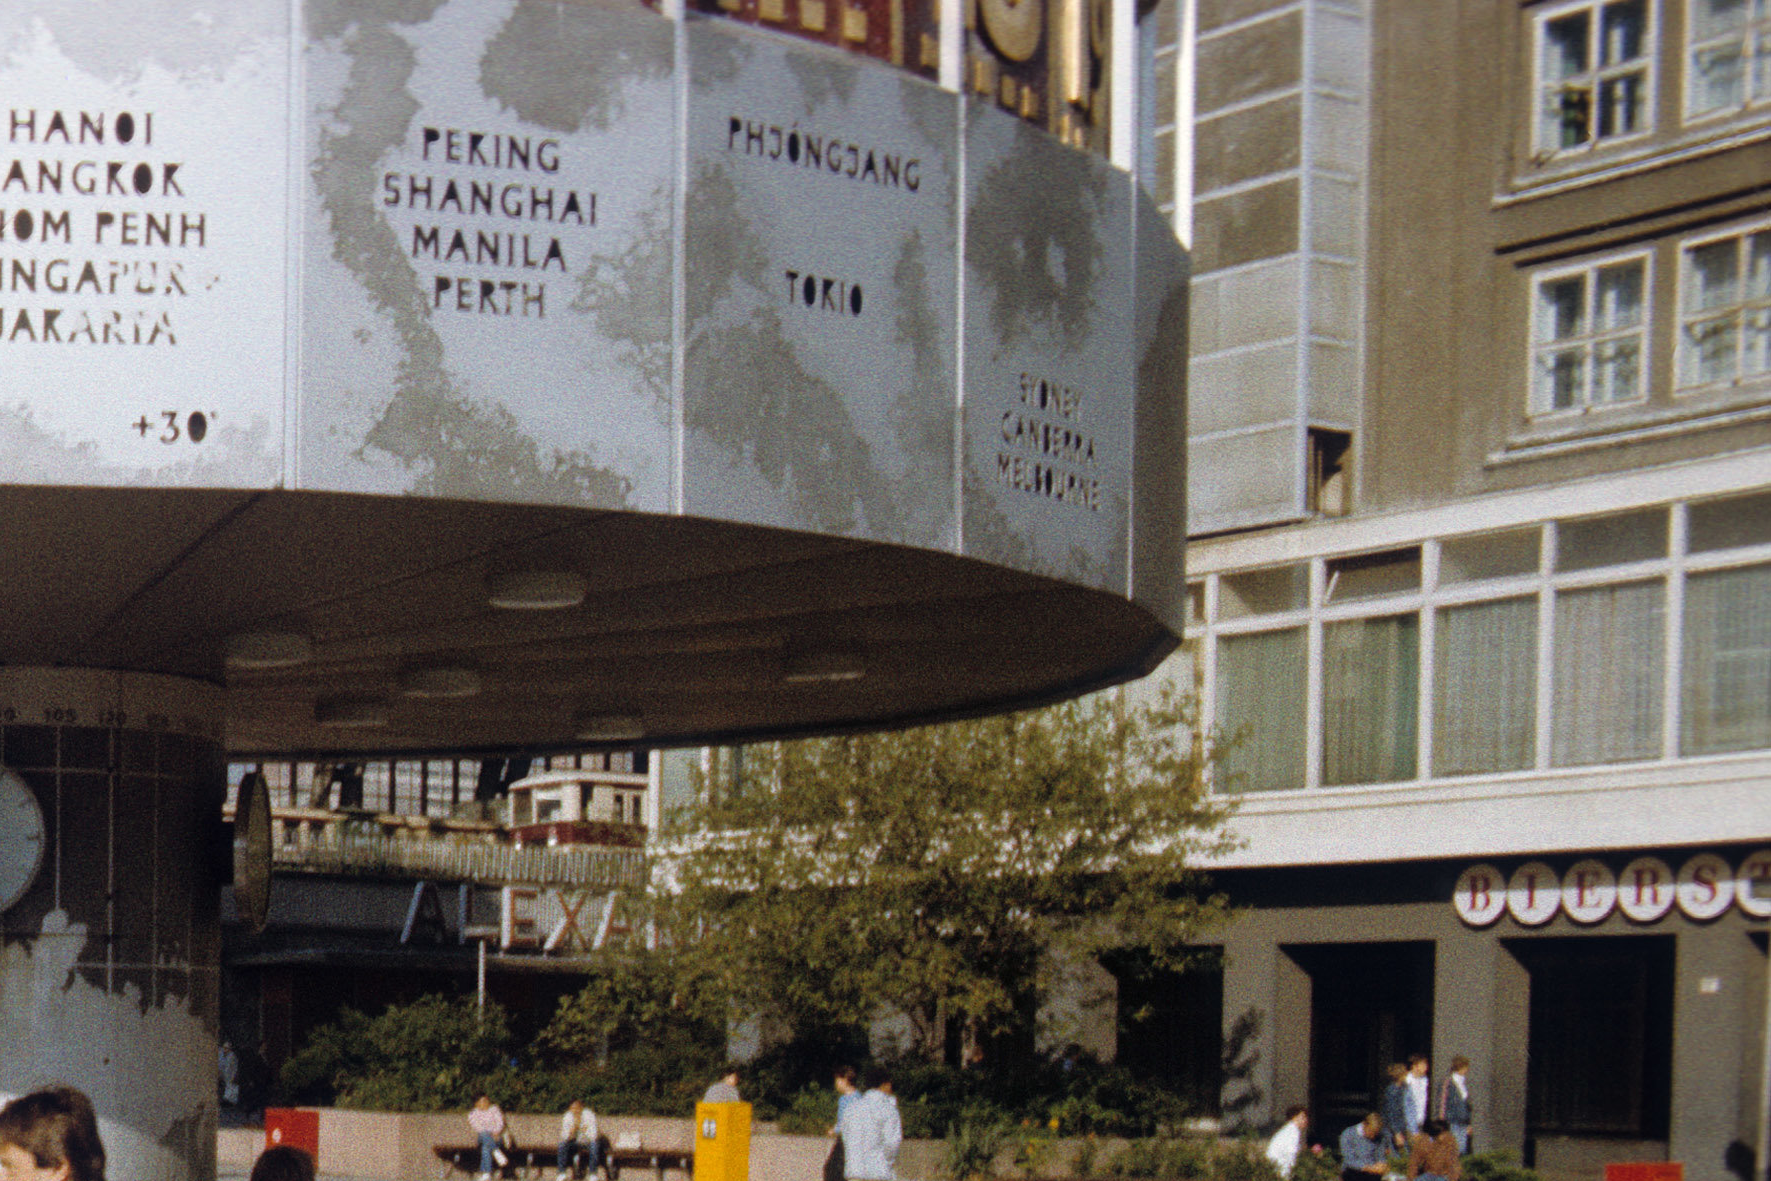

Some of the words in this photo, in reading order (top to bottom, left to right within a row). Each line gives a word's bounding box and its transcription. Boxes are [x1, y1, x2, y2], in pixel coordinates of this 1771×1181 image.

[9, 109, 154, 145] HANOI
[422, 127, 561, 174] PEKING
[383, 173, 597, 226] SHANGHAI
[95, 212, 207, 247] PENH
[412, 225, 567, 272] MANILA
[433, 277, 547, 318] PERTH
[785, 270, 863, 317] TOKIO
[1001, 410, 1098, 467] CANBERRA
[996, 451, 1100, 511] MELBOURNE
